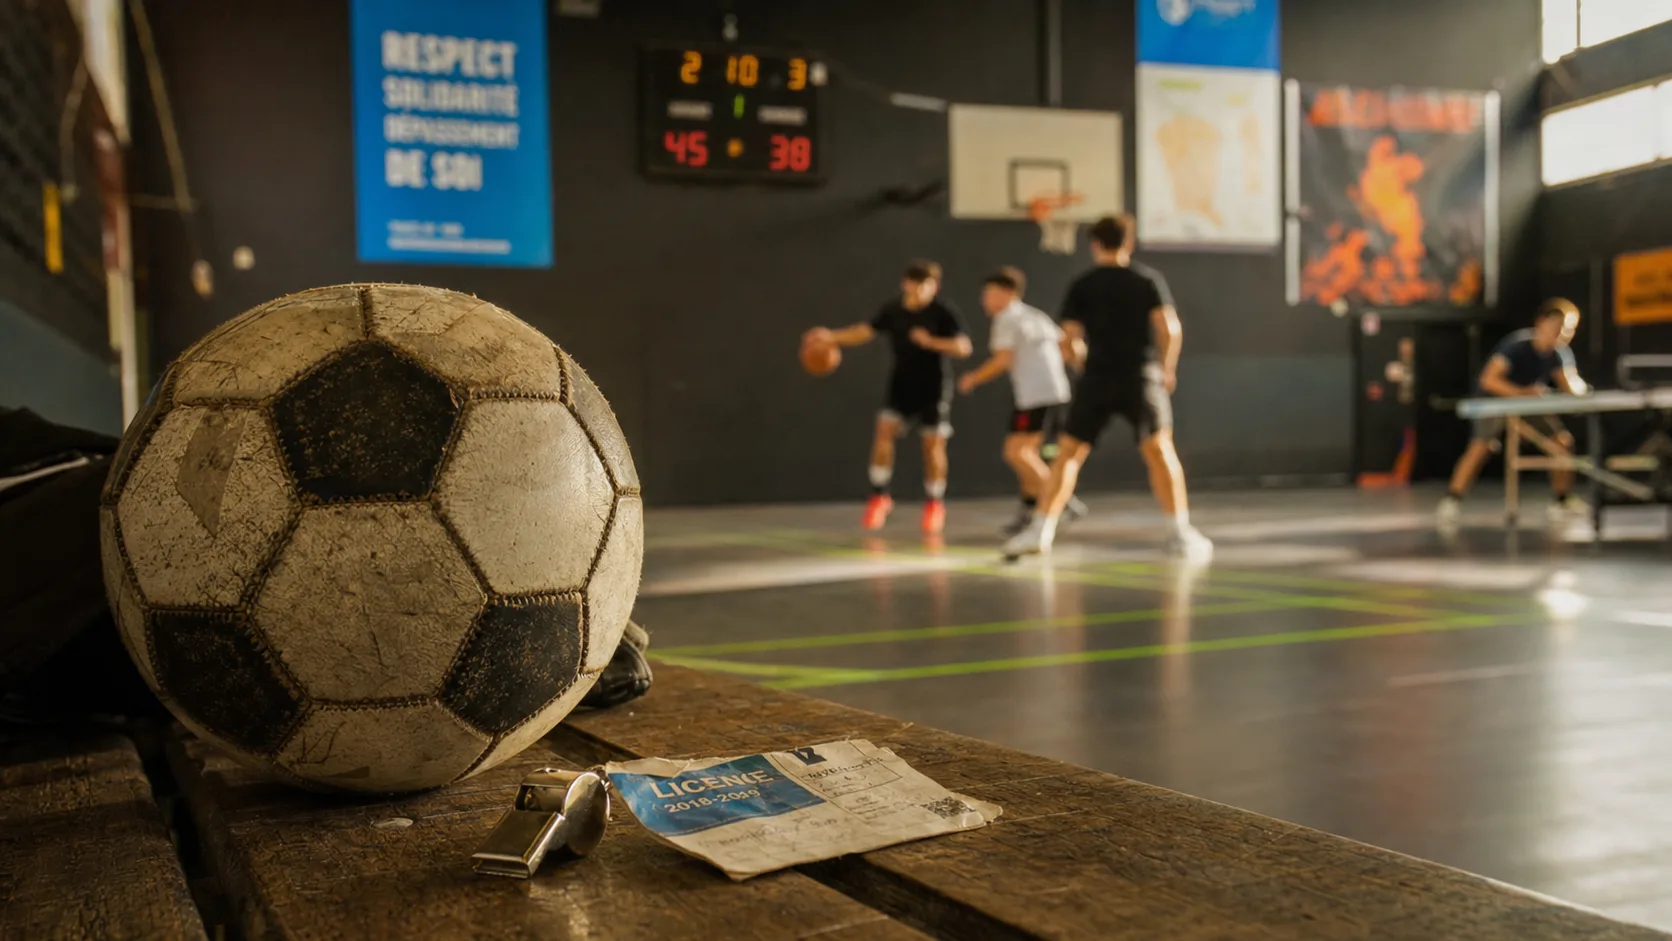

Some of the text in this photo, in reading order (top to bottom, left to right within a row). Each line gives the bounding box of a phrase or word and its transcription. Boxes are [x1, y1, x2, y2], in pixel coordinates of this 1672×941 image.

[382, 30, 516, 78] RESPECT
[680, 50, 807, 91] 2 10 3
[385, 148, 483, 191] DE SOI
[664, 130, 812, 172] 45 38
[649, 770, 774, 799] LICENCE
